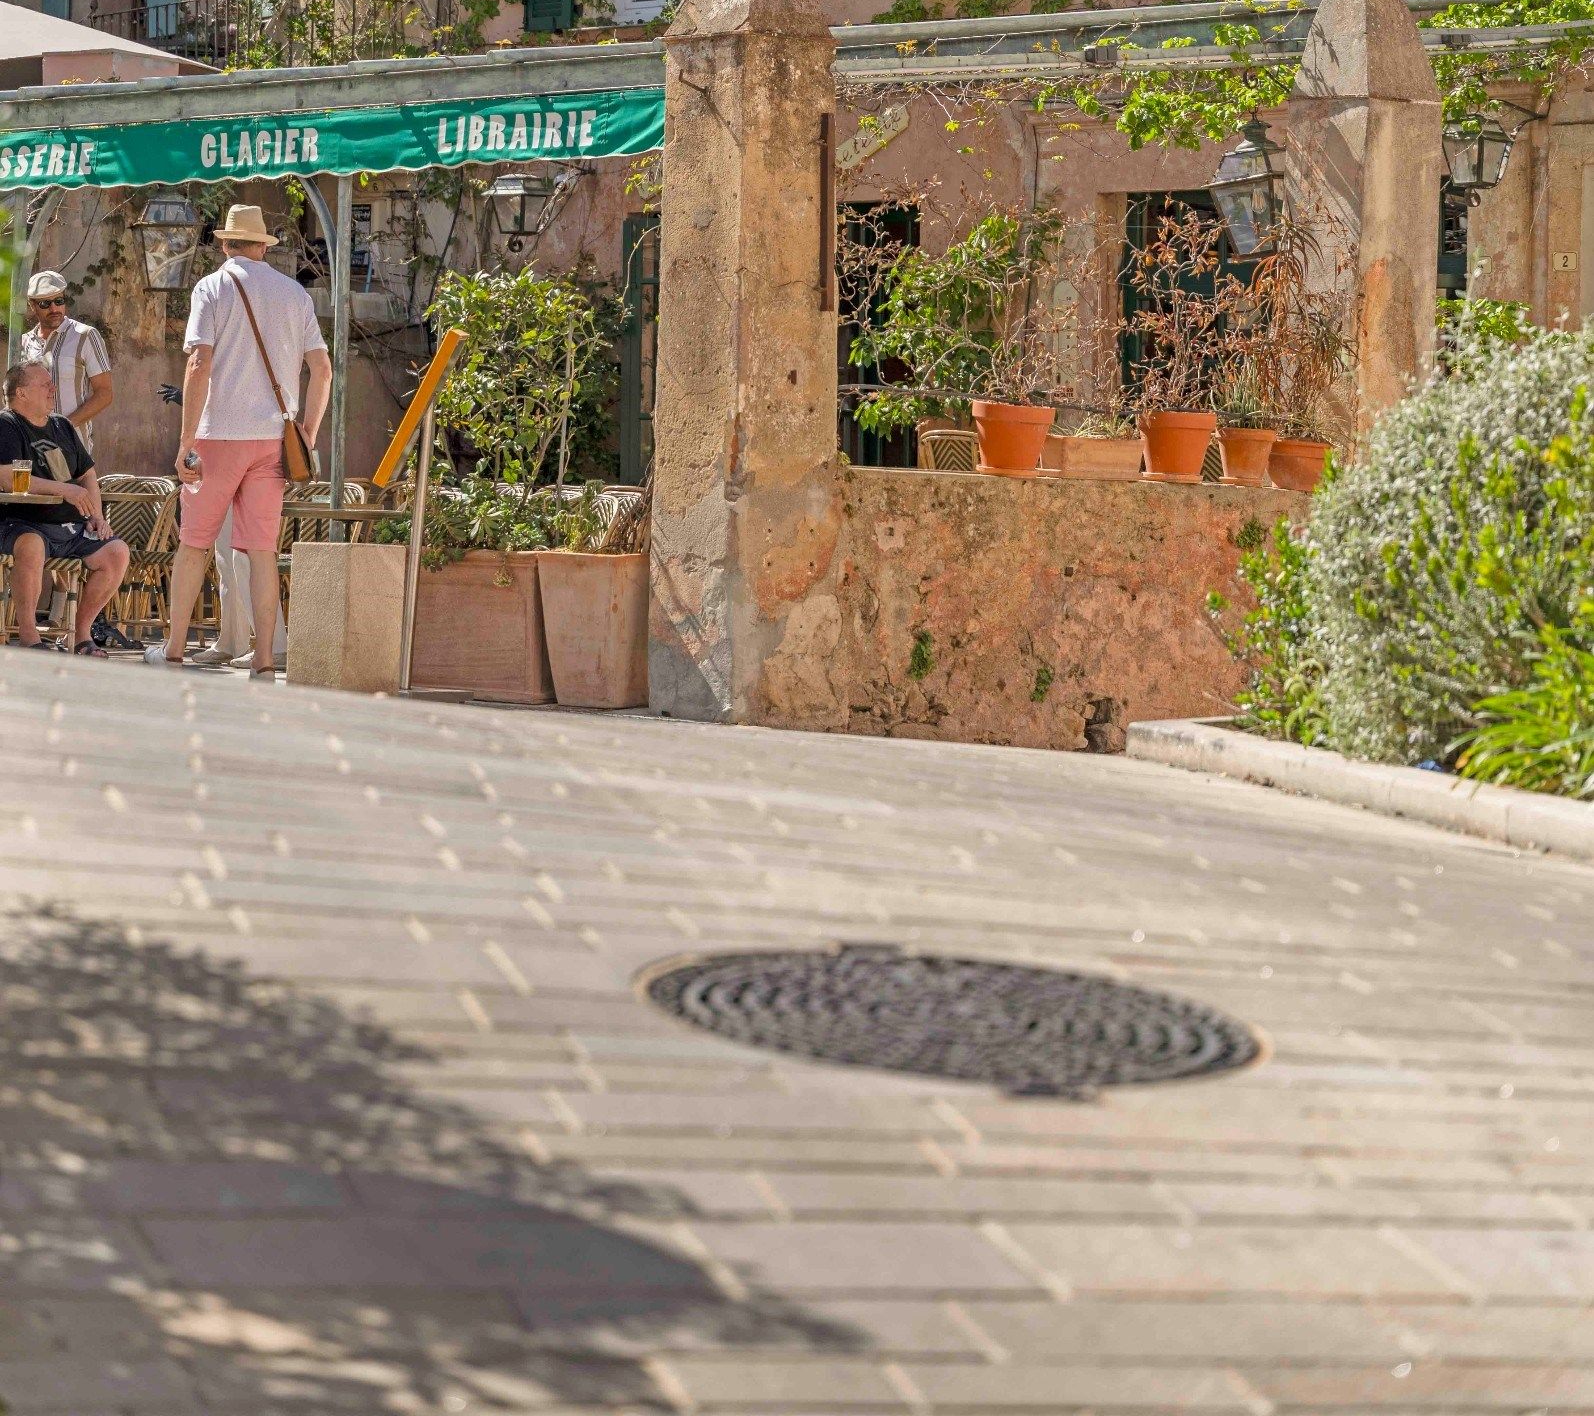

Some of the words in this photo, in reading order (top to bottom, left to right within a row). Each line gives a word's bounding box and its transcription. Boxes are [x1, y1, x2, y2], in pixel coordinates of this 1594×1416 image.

[0, 142, 95, 179] SSERIE
[200, 127, 319, 168] GLACIER
[437, 109, 598, 155] LIBRAIRIE
[1562, 254, 1570, 268] 2
